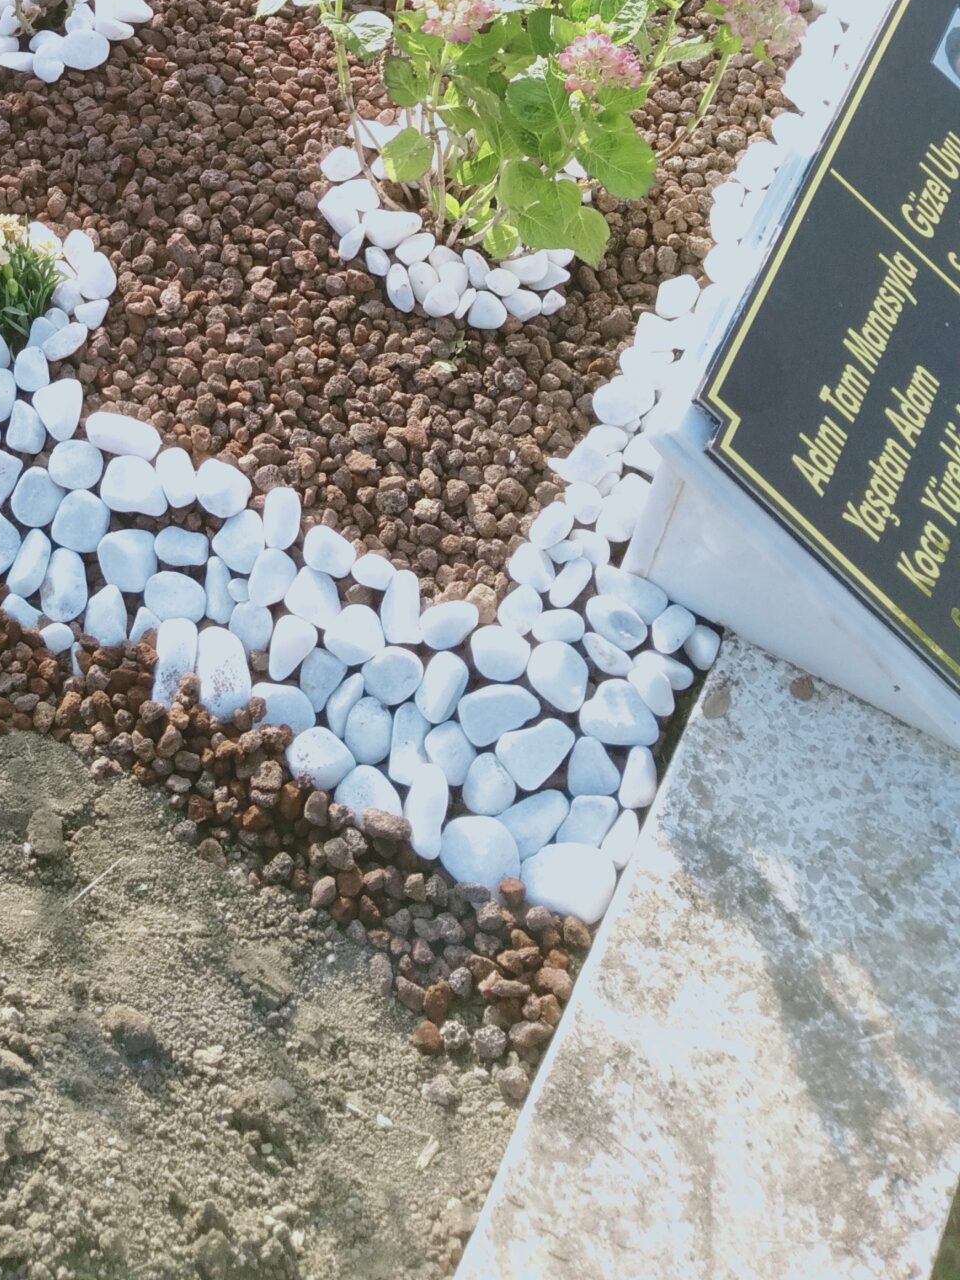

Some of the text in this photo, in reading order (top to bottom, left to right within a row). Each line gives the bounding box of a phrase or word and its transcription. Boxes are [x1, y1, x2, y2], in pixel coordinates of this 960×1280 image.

[901, 161, 952, 239] Güzel
[791, 250, 919, 498] Adını Tam Manasıyla
[841, 364, 941, 543] Yaşatan Adam
[896, 520, 952, 599] Koca
